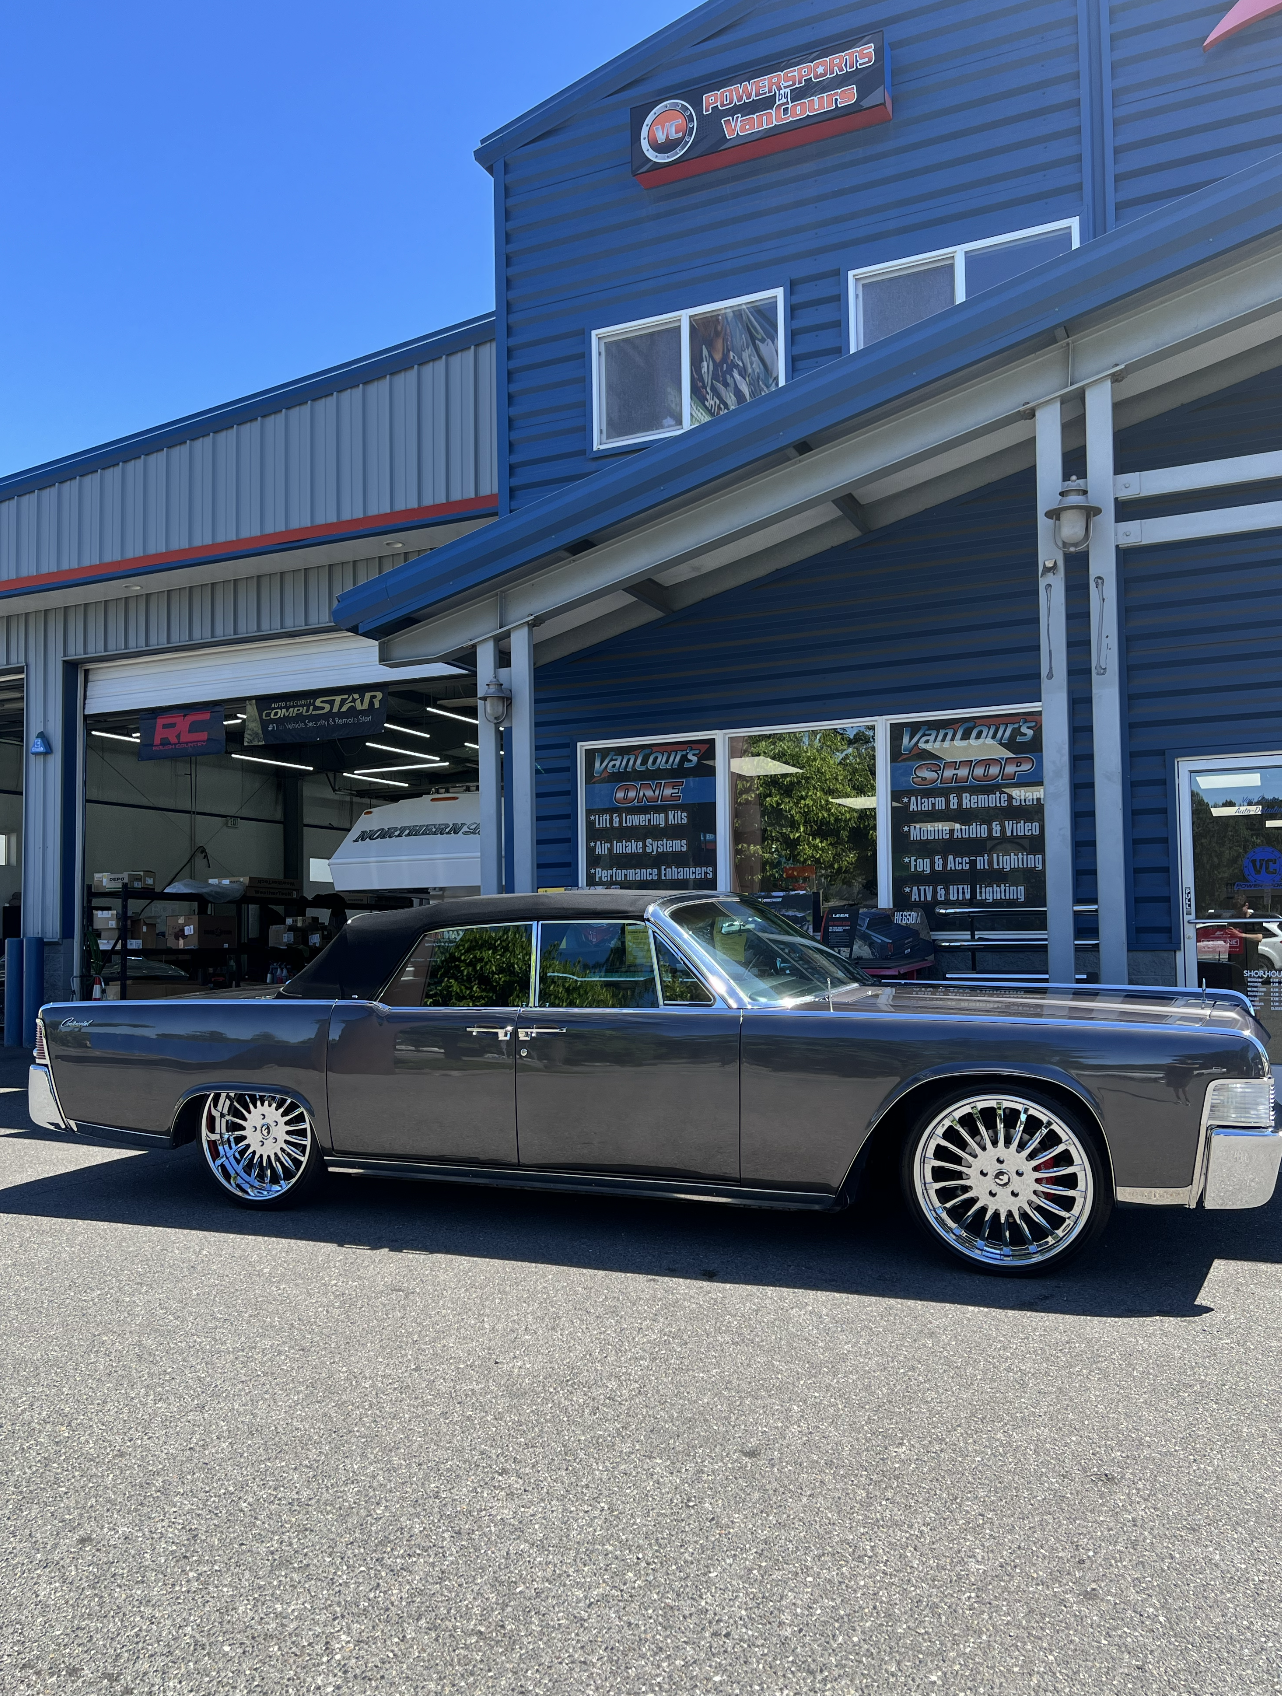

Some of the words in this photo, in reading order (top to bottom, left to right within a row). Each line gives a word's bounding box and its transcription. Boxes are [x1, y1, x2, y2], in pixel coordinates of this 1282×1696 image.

[703, 44, 875, 114] POWERSPORTS
[776, 88, 790, 104] by
[721, 85, 857, 139] VanCours
[653, 119, 683, 144] VC
[286, 699, 314, 707] SECURITY
[153, 711, 211, 746] RC
[268, 723, 277, 731] #1
[285, 720, 305, 729] Vehicle
[306, 719, 328, 729] Security
[335, 716, 358, 725] Remote
[358, 714, 372, 722] Start
[175, 741, 207, 749] COUNTRY
[901, 718, 1037, 754] VanCour's
[593, 746, 700, 777] VanCour's
[911, 755, 1036, 787] SHOP
[613, 780, 686, 806] ONE
[949, 794, 958, 809] &
[962, 791, 1008, 809] Remote
[1012, 788, 1044, 806] Start
[613, 813, 620, 827] &
[622, 811, 665, 828] Lowering
[668, 810, 688, 825] Kits
[353, 822, 467, 843] NORTHERN
[953, 822, 988, 839] Audio
[992, 821, 1002, 837] &
[1004, 820, 1040, 837] Video
[613, 839, 643, 854] Intake
[645, 838, 687, 855] Systems
[934, 855, 944, 871] &
[947, 854, 989, 870] Accnt
[992, 852, 1043, 871] Lighting
[1250, 858, 1277, 875] VC
[661, 865, 713, 880] Enhancers
[937, 885, 946, 901] &
[949, 884, 971, 900] UTV
[976, 884, 1025, 902] Lighting
